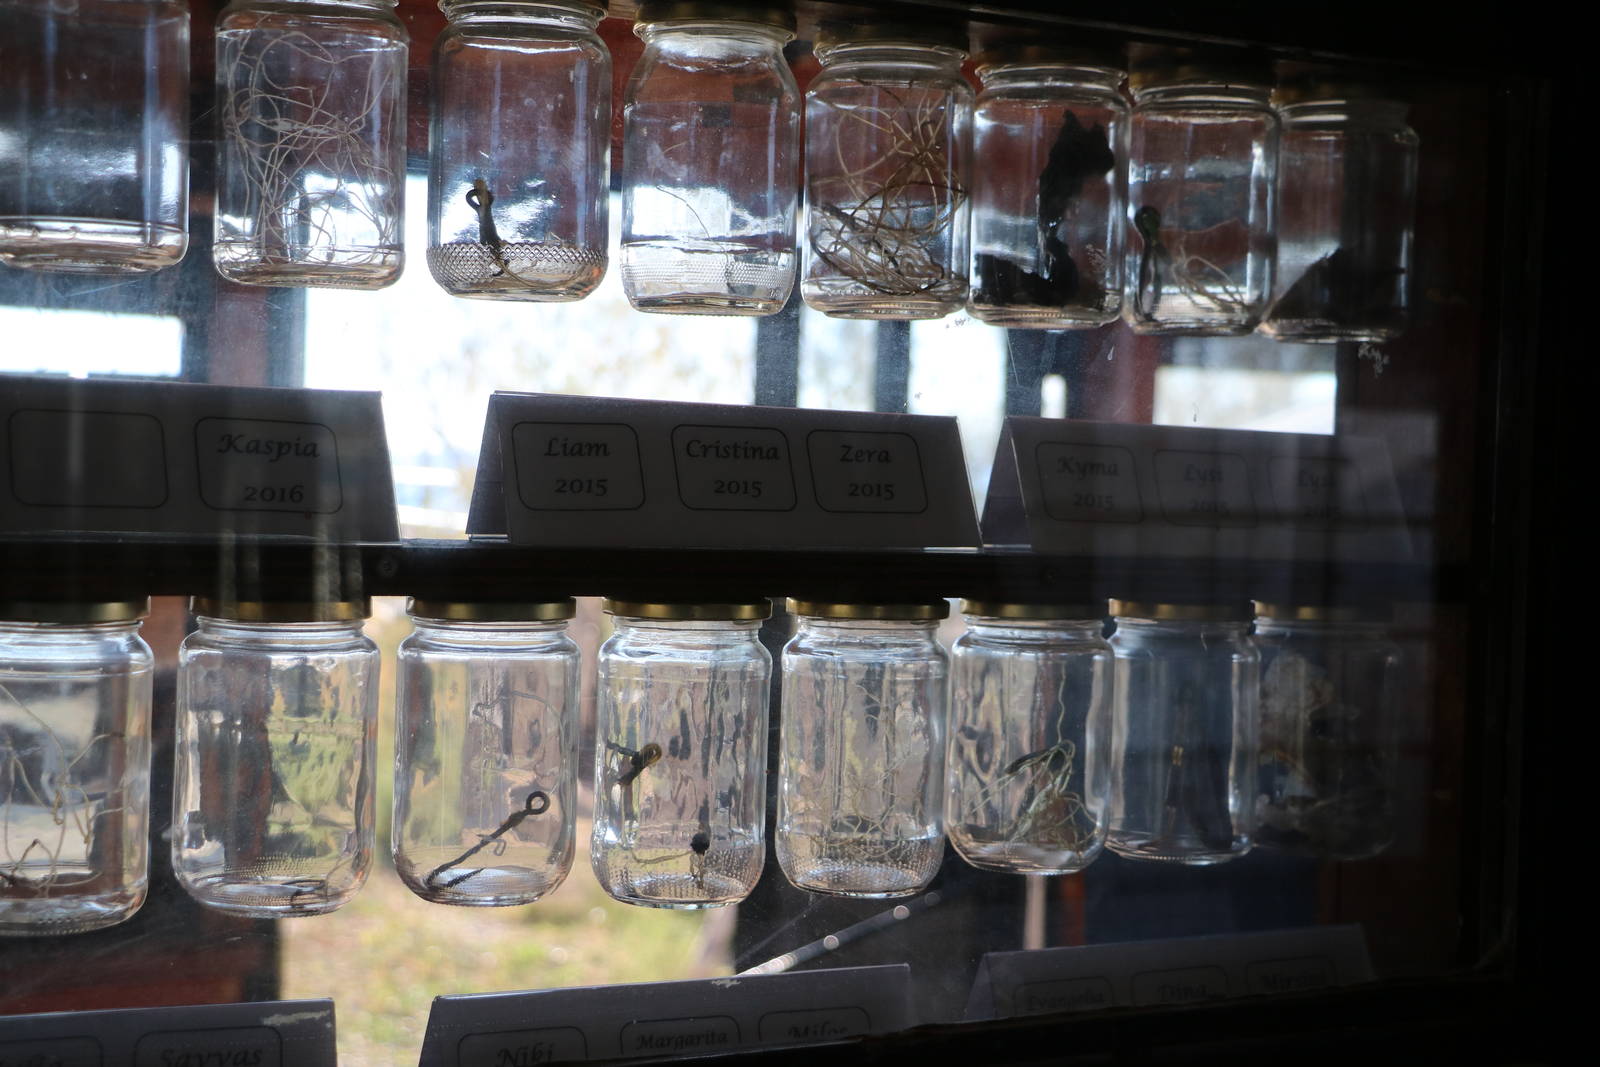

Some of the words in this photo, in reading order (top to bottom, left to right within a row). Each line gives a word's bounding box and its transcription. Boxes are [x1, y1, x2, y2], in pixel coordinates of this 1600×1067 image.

[217, 434, 320, 462] Kaspia
[544, 437, 610, 458] Liam
[686, 438, 780, 461] Cristina
[839, 443, 892, 465] Zera
[1056, 455, 1119, 480] Kyma
[243, 484, 305, 504] 2016
[554, 477, 609, 497] 2015
[713, 478, 763, 498] 2015
[848, 482, 896, 501] 2015
[1072, 493, 1114, 512] 2015
[635, 1030, 729, 1050] Margarita
[160, 1048, 263, 1067] Savvas
[495, 1042, 555, 1066] Niki
